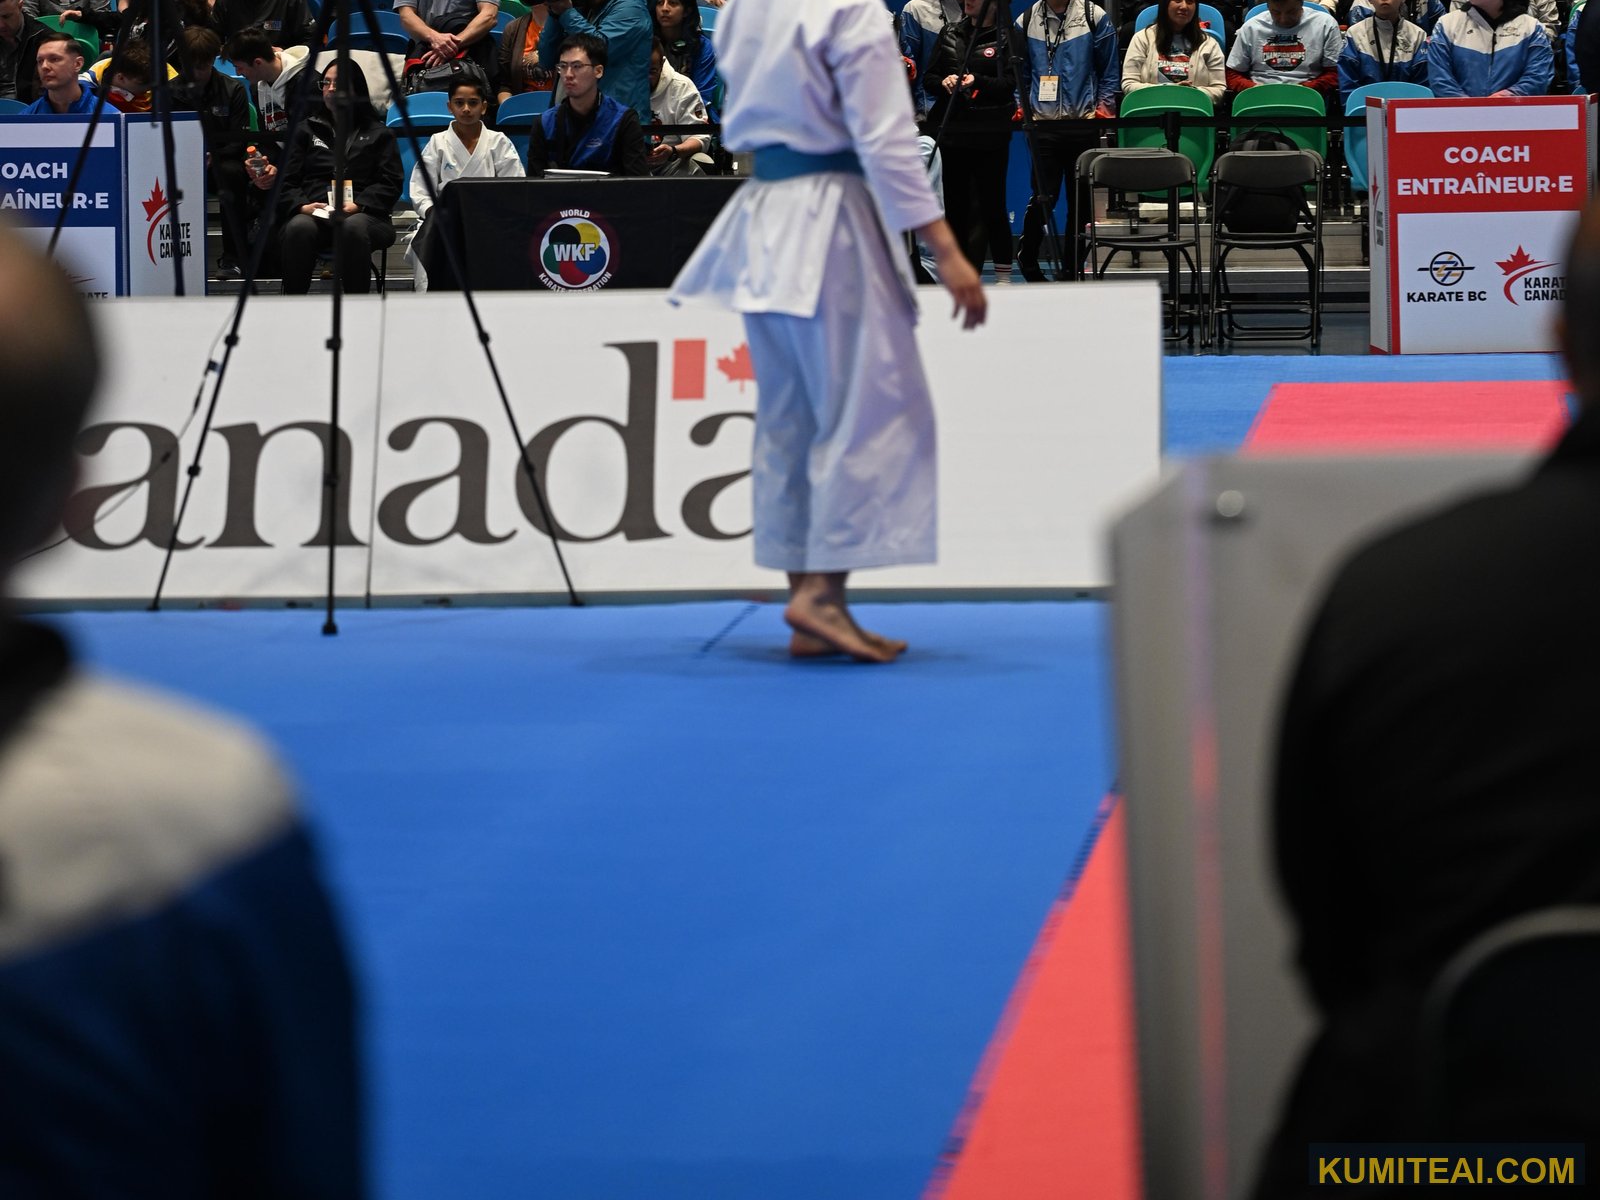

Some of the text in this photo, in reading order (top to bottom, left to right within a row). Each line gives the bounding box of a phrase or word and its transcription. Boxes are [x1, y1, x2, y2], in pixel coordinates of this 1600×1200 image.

[1444, 145, 1530, 164] COACH
[0, 162, 68, 180] OACH
[1397, 172, 1573, 196] ENTRAÎNEUR·E
[0, 187, 110, 210] AÎNER·E
[560, 208, 591, 218] WORLD
[160, 223, 190, 240] KAATE
[553, 243, 596, 261] WKF
[1524, 276, 1567, 289] KARAT
[1406, 290, 1487, 303] KARATE BC
[1524, 289, 1567, 302] CANAD
[62, 340, 754, 551] anada
